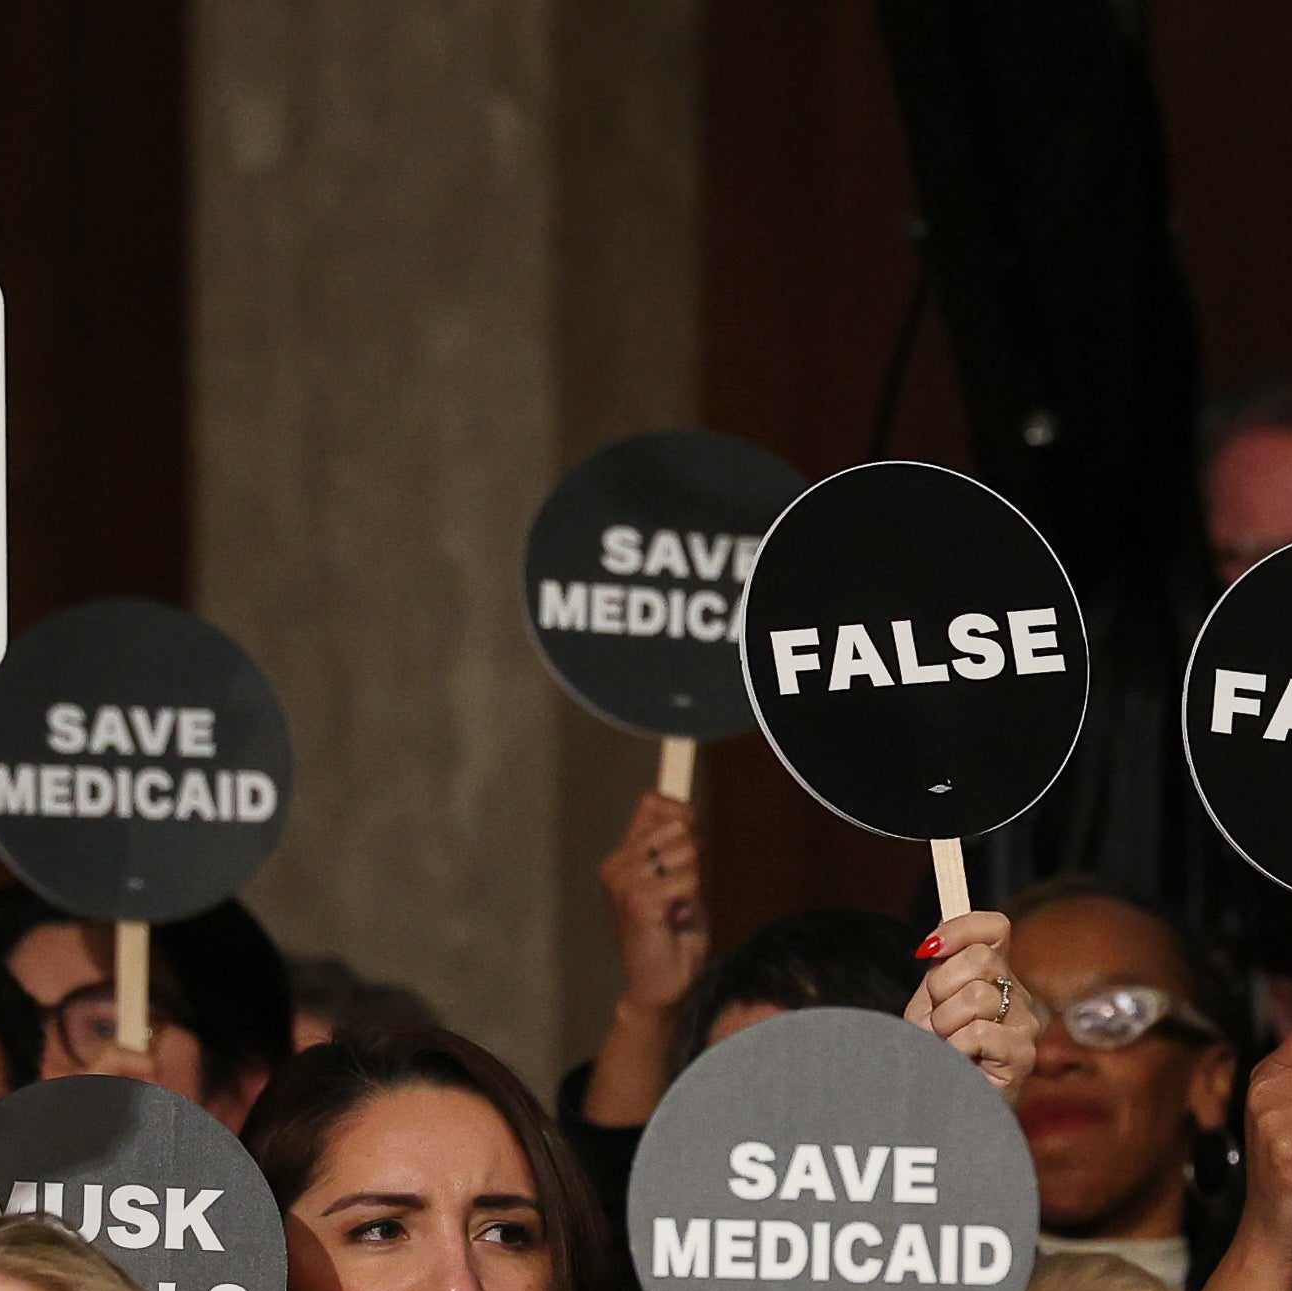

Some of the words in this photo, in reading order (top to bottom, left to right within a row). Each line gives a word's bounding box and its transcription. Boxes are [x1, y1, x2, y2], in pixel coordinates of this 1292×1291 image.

[538, 580, 741, 645] MEDIC
[769, 607, 1066, 696] FALSE
[46, 702, 218, 759] SAVE
[727, 1141, 939, 1204] SAVE
[652, 1216, 1013, 1285] MEDICAID
